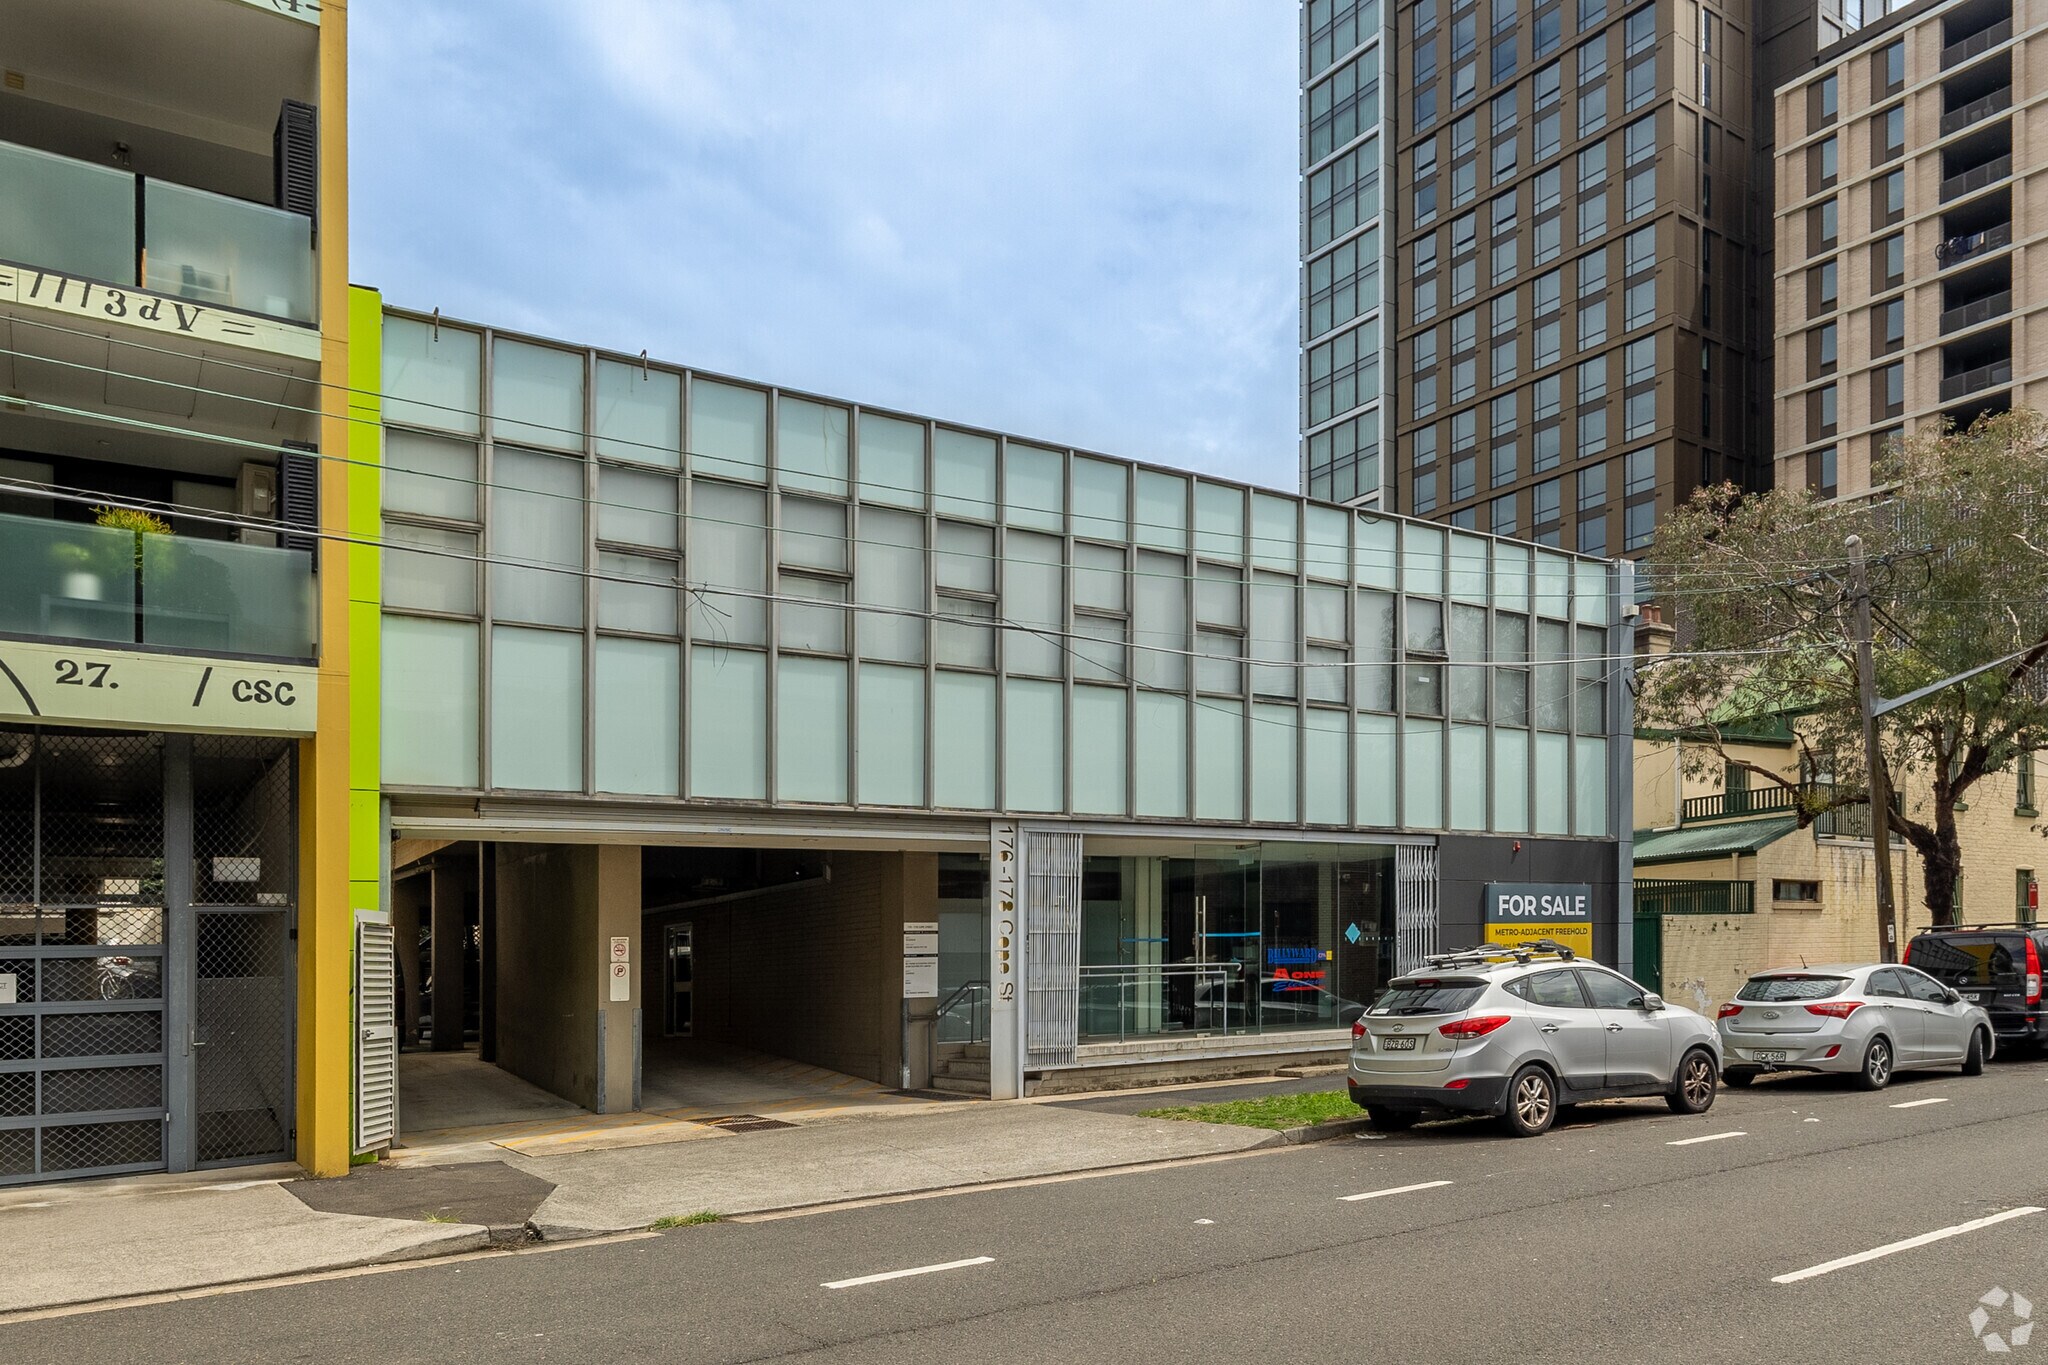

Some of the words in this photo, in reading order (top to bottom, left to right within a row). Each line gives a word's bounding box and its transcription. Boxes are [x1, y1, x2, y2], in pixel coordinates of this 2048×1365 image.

[54, 659, 120, 690] 27.
[1498, 894, 1537, 916] FOR
[1540, 895, 1586, 916] SALE
[1495, 928, 1554, 936] METRO-ADJACENT
[1555, 927, 1588, 935] FREEHOLD
[1291, 970, 1327, 979] ONE
[999, 982, 1014, 1002] St
